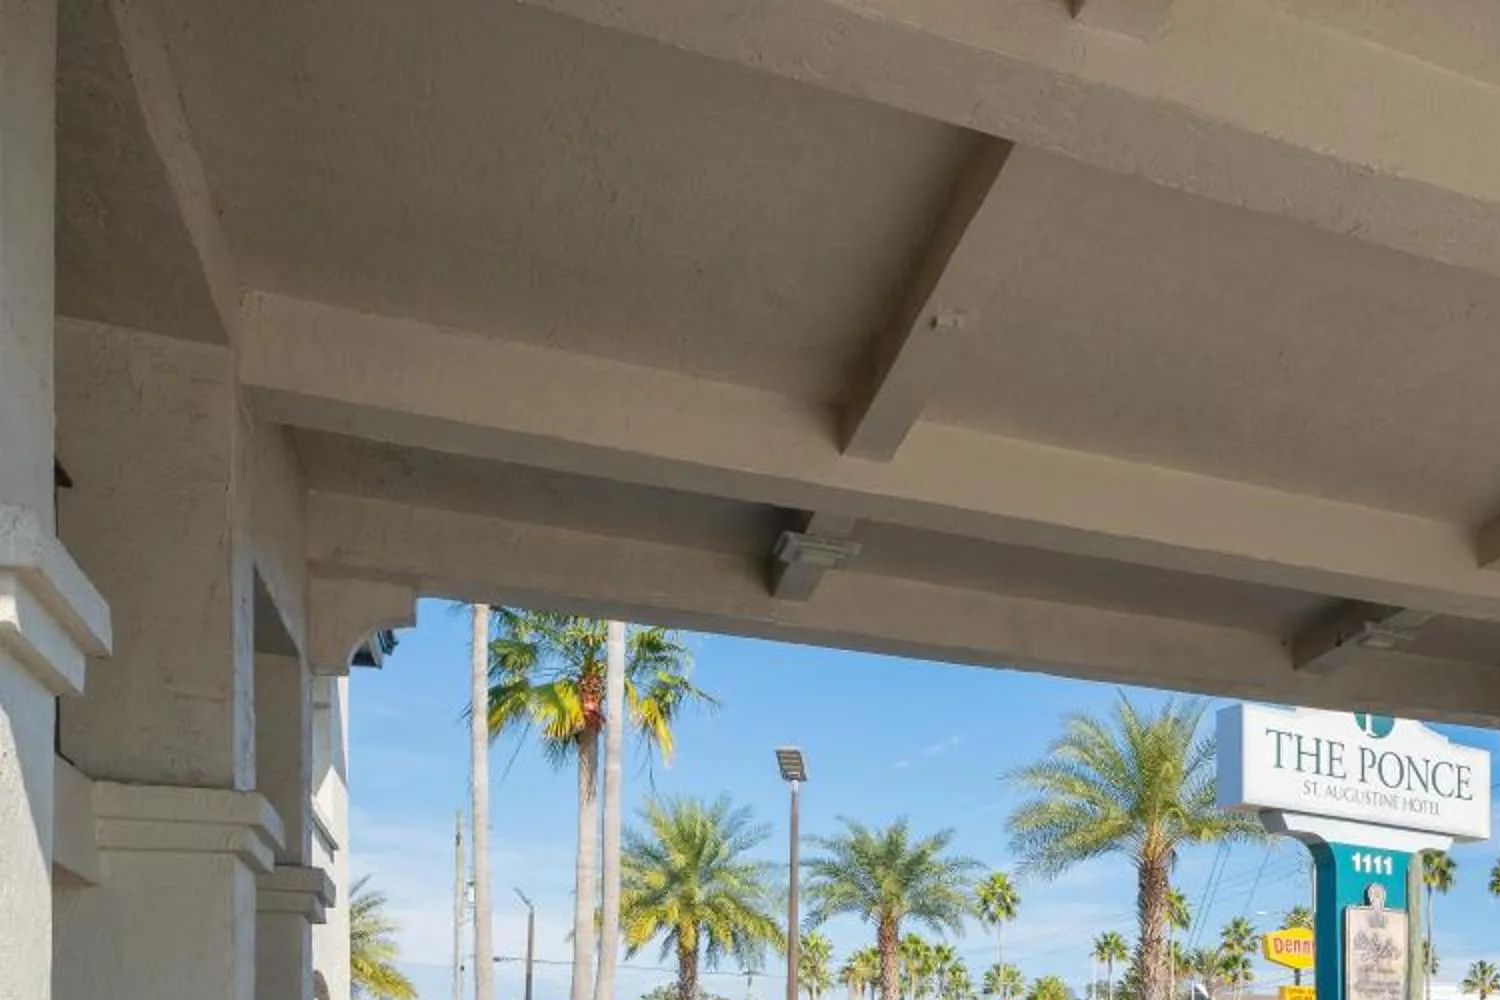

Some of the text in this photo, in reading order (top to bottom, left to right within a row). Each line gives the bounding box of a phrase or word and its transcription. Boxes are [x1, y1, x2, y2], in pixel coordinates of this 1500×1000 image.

[1265, 728, 1473, 801] THE PONCE
[1302, 779, 1440, 816] ST. AUGUSTINE HOTEL
[1352, 852, 1393, 875] 1111
[1273, 937, 1315, 954] Denn
